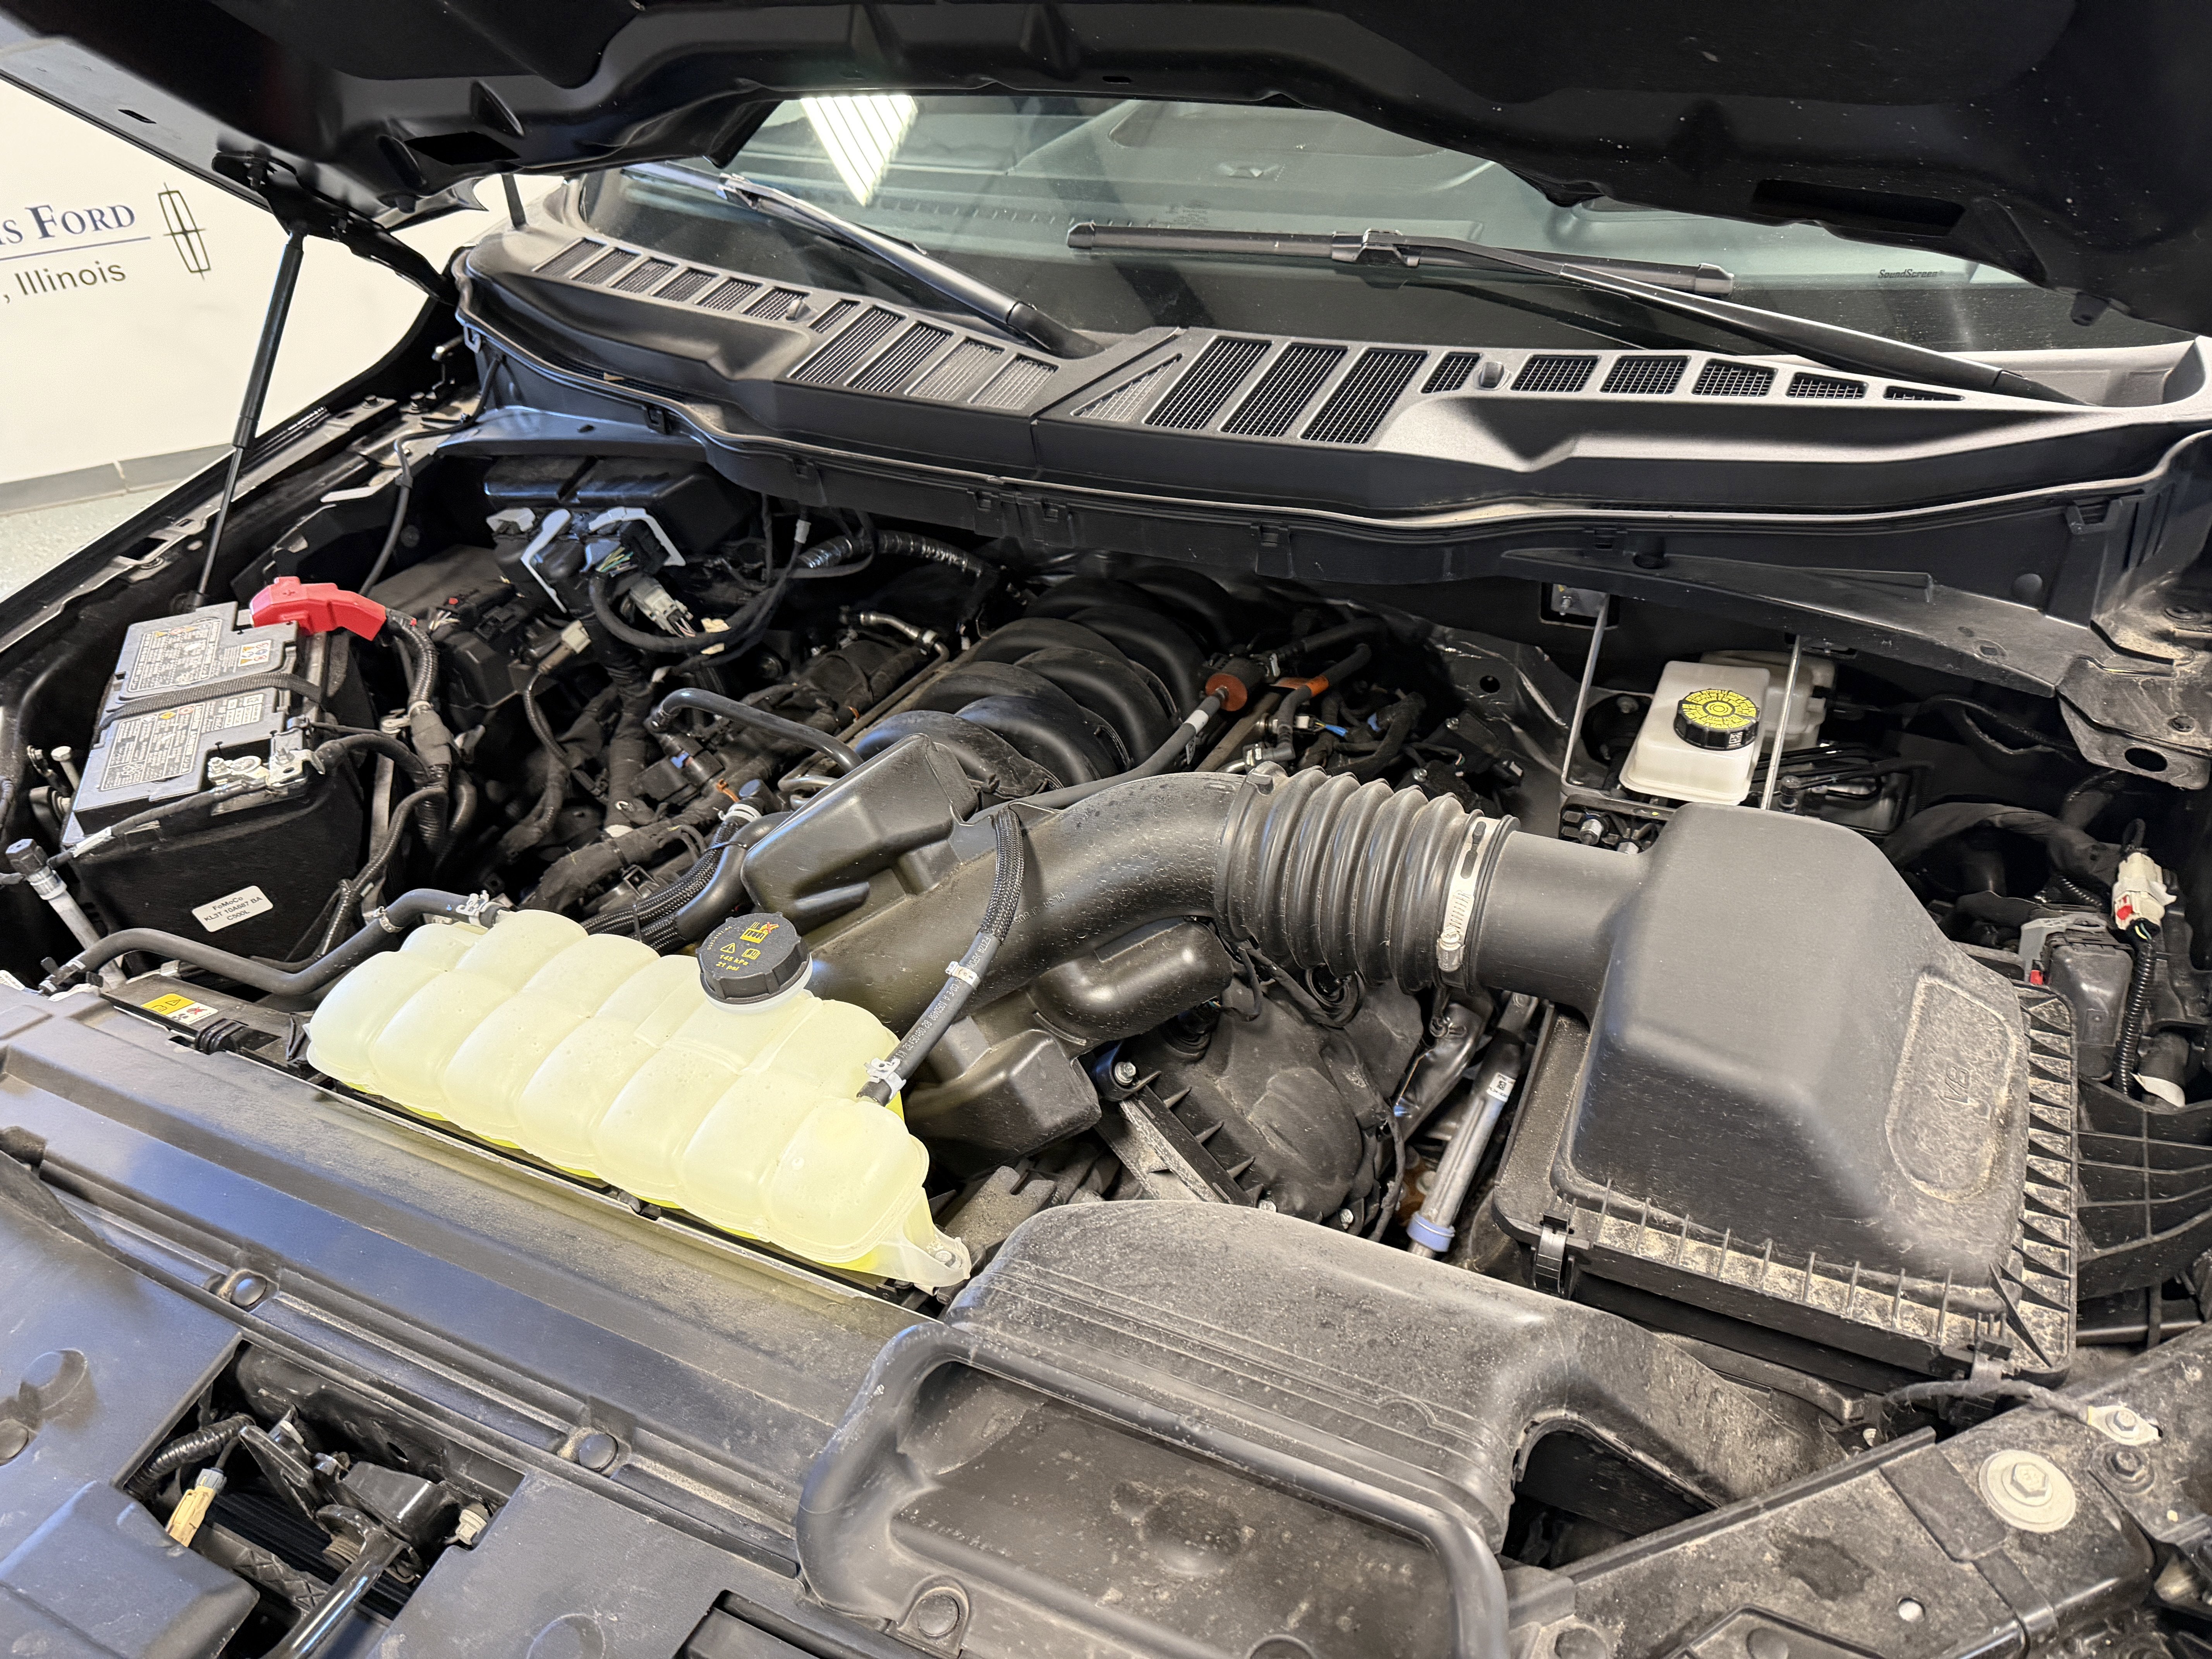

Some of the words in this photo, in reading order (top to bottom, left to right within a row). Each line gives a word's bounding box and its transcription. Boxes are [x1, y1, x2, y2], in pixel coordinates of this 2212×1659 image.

[0, 220, 23, 245] S
[24, 204, 135, 239] FORD
[14, 260, 127, 295] Illinois
[212, 897, 243, 910] FoMoCo
[734, 958, 749, 966] kPa
[1944, 1062, 1970, 1103] V8
